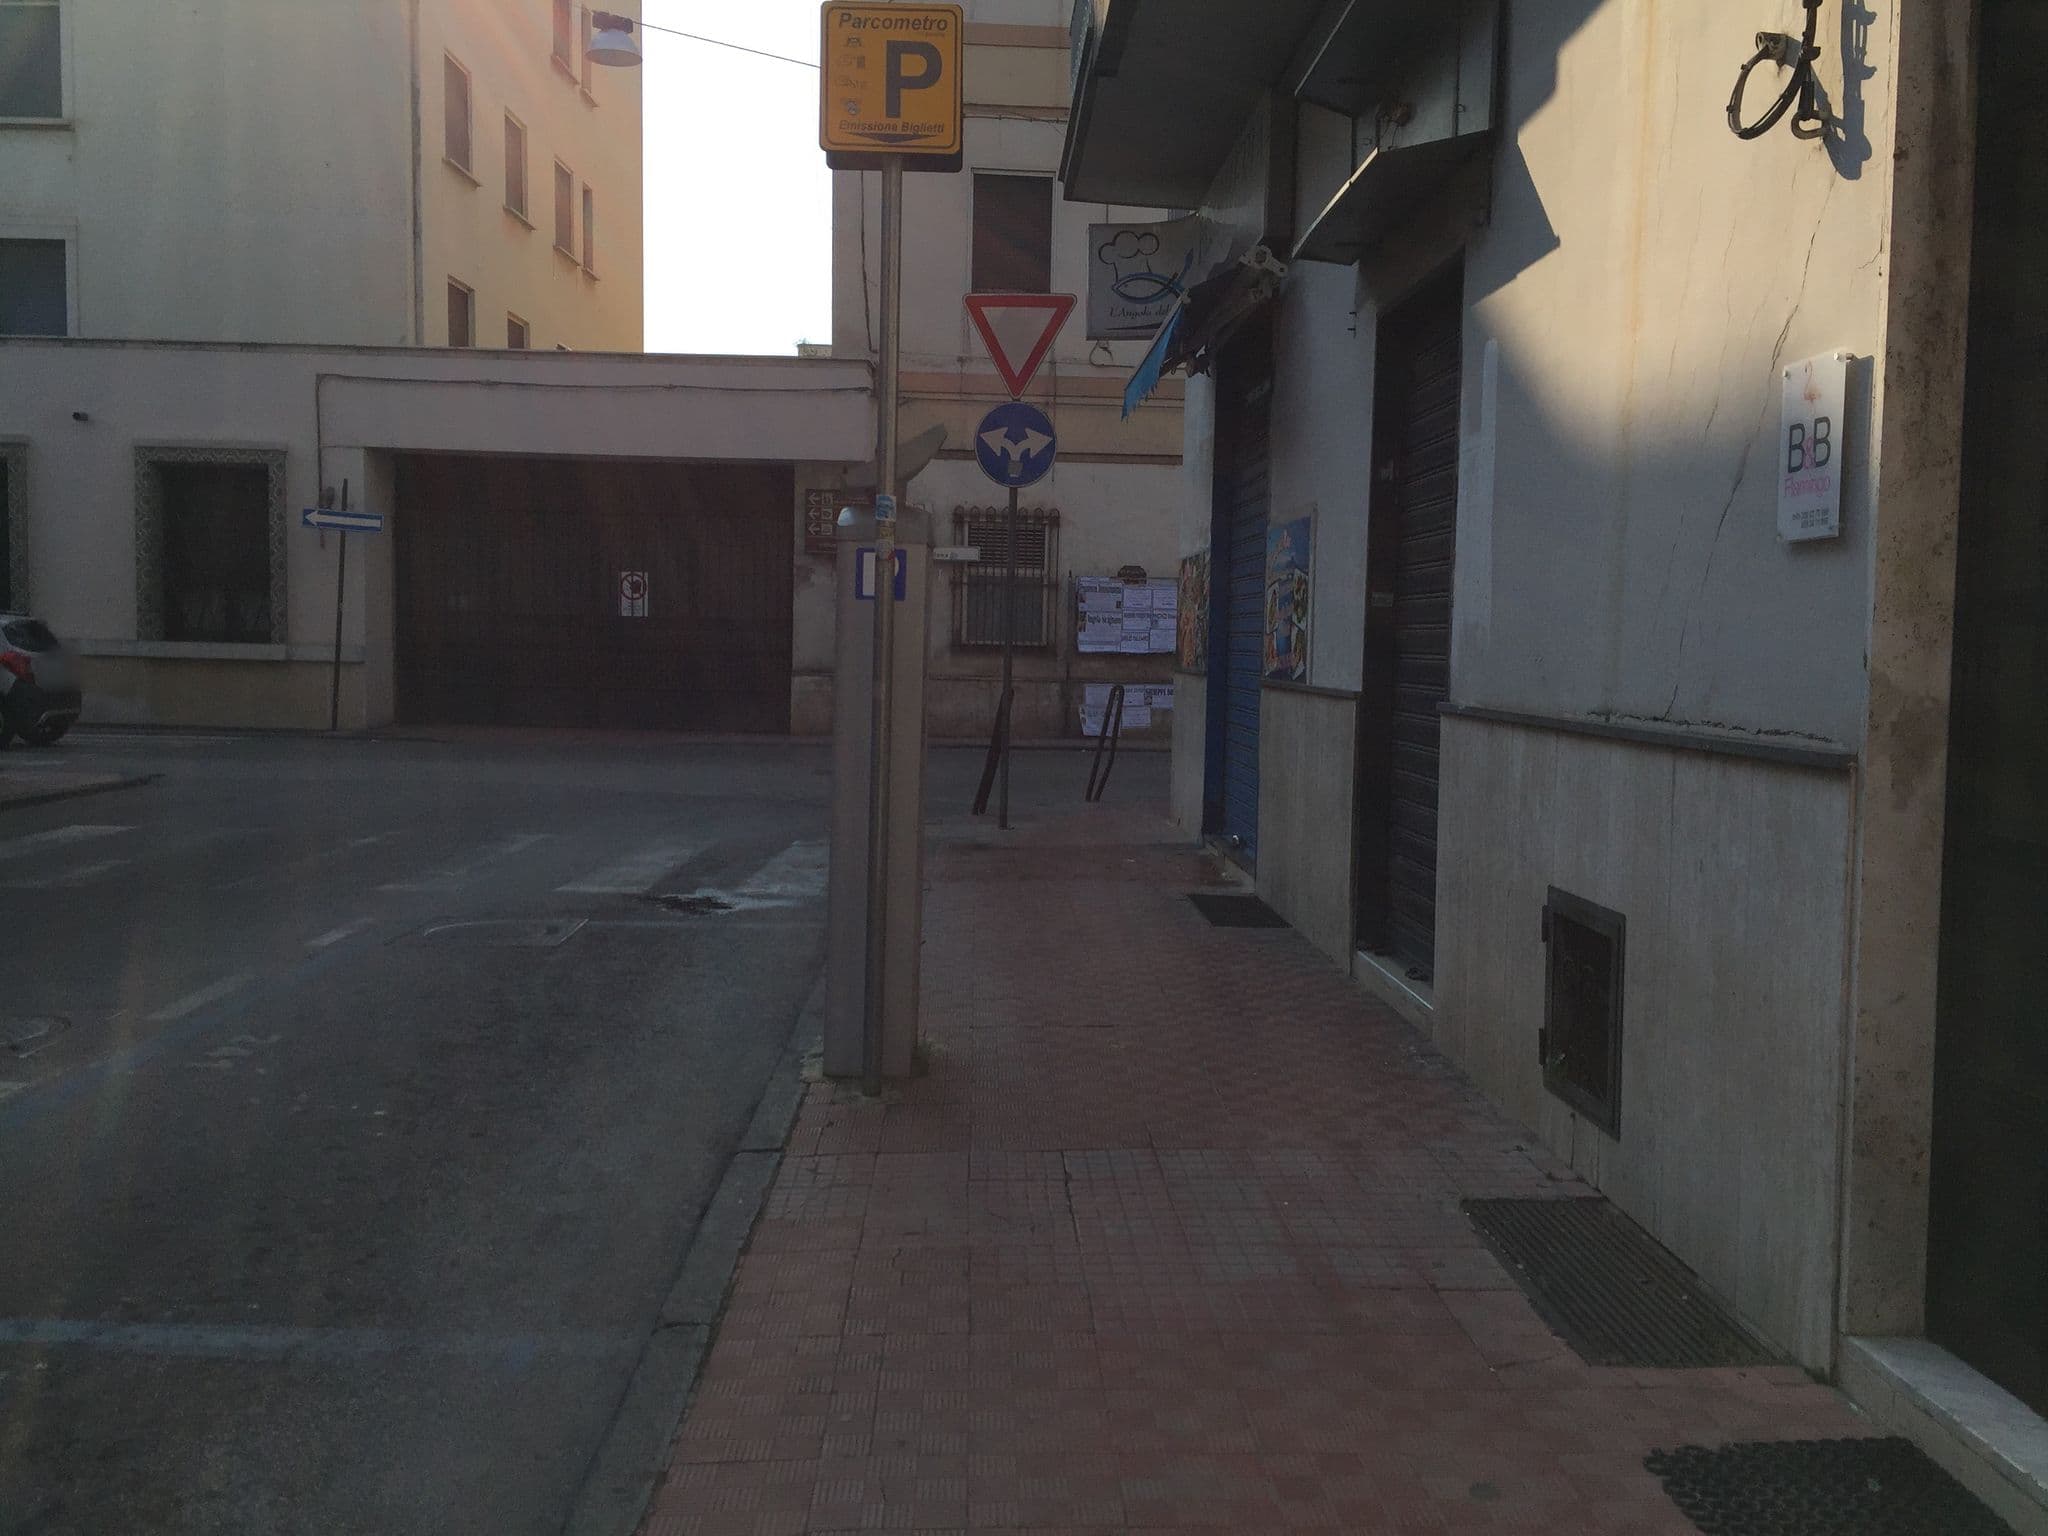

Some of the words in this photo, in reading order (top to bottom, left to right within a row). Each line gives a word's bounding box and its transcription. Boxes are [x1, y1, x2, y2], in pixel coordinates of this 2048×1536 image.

[838, 12, 948, 32] Parcometro
[885, 40, 943, 119] P
[838, 119, 898, 132] Emissione
[901, 122, 945, 134] Biglietti
[1787, 416, 1831, 474] B&B
